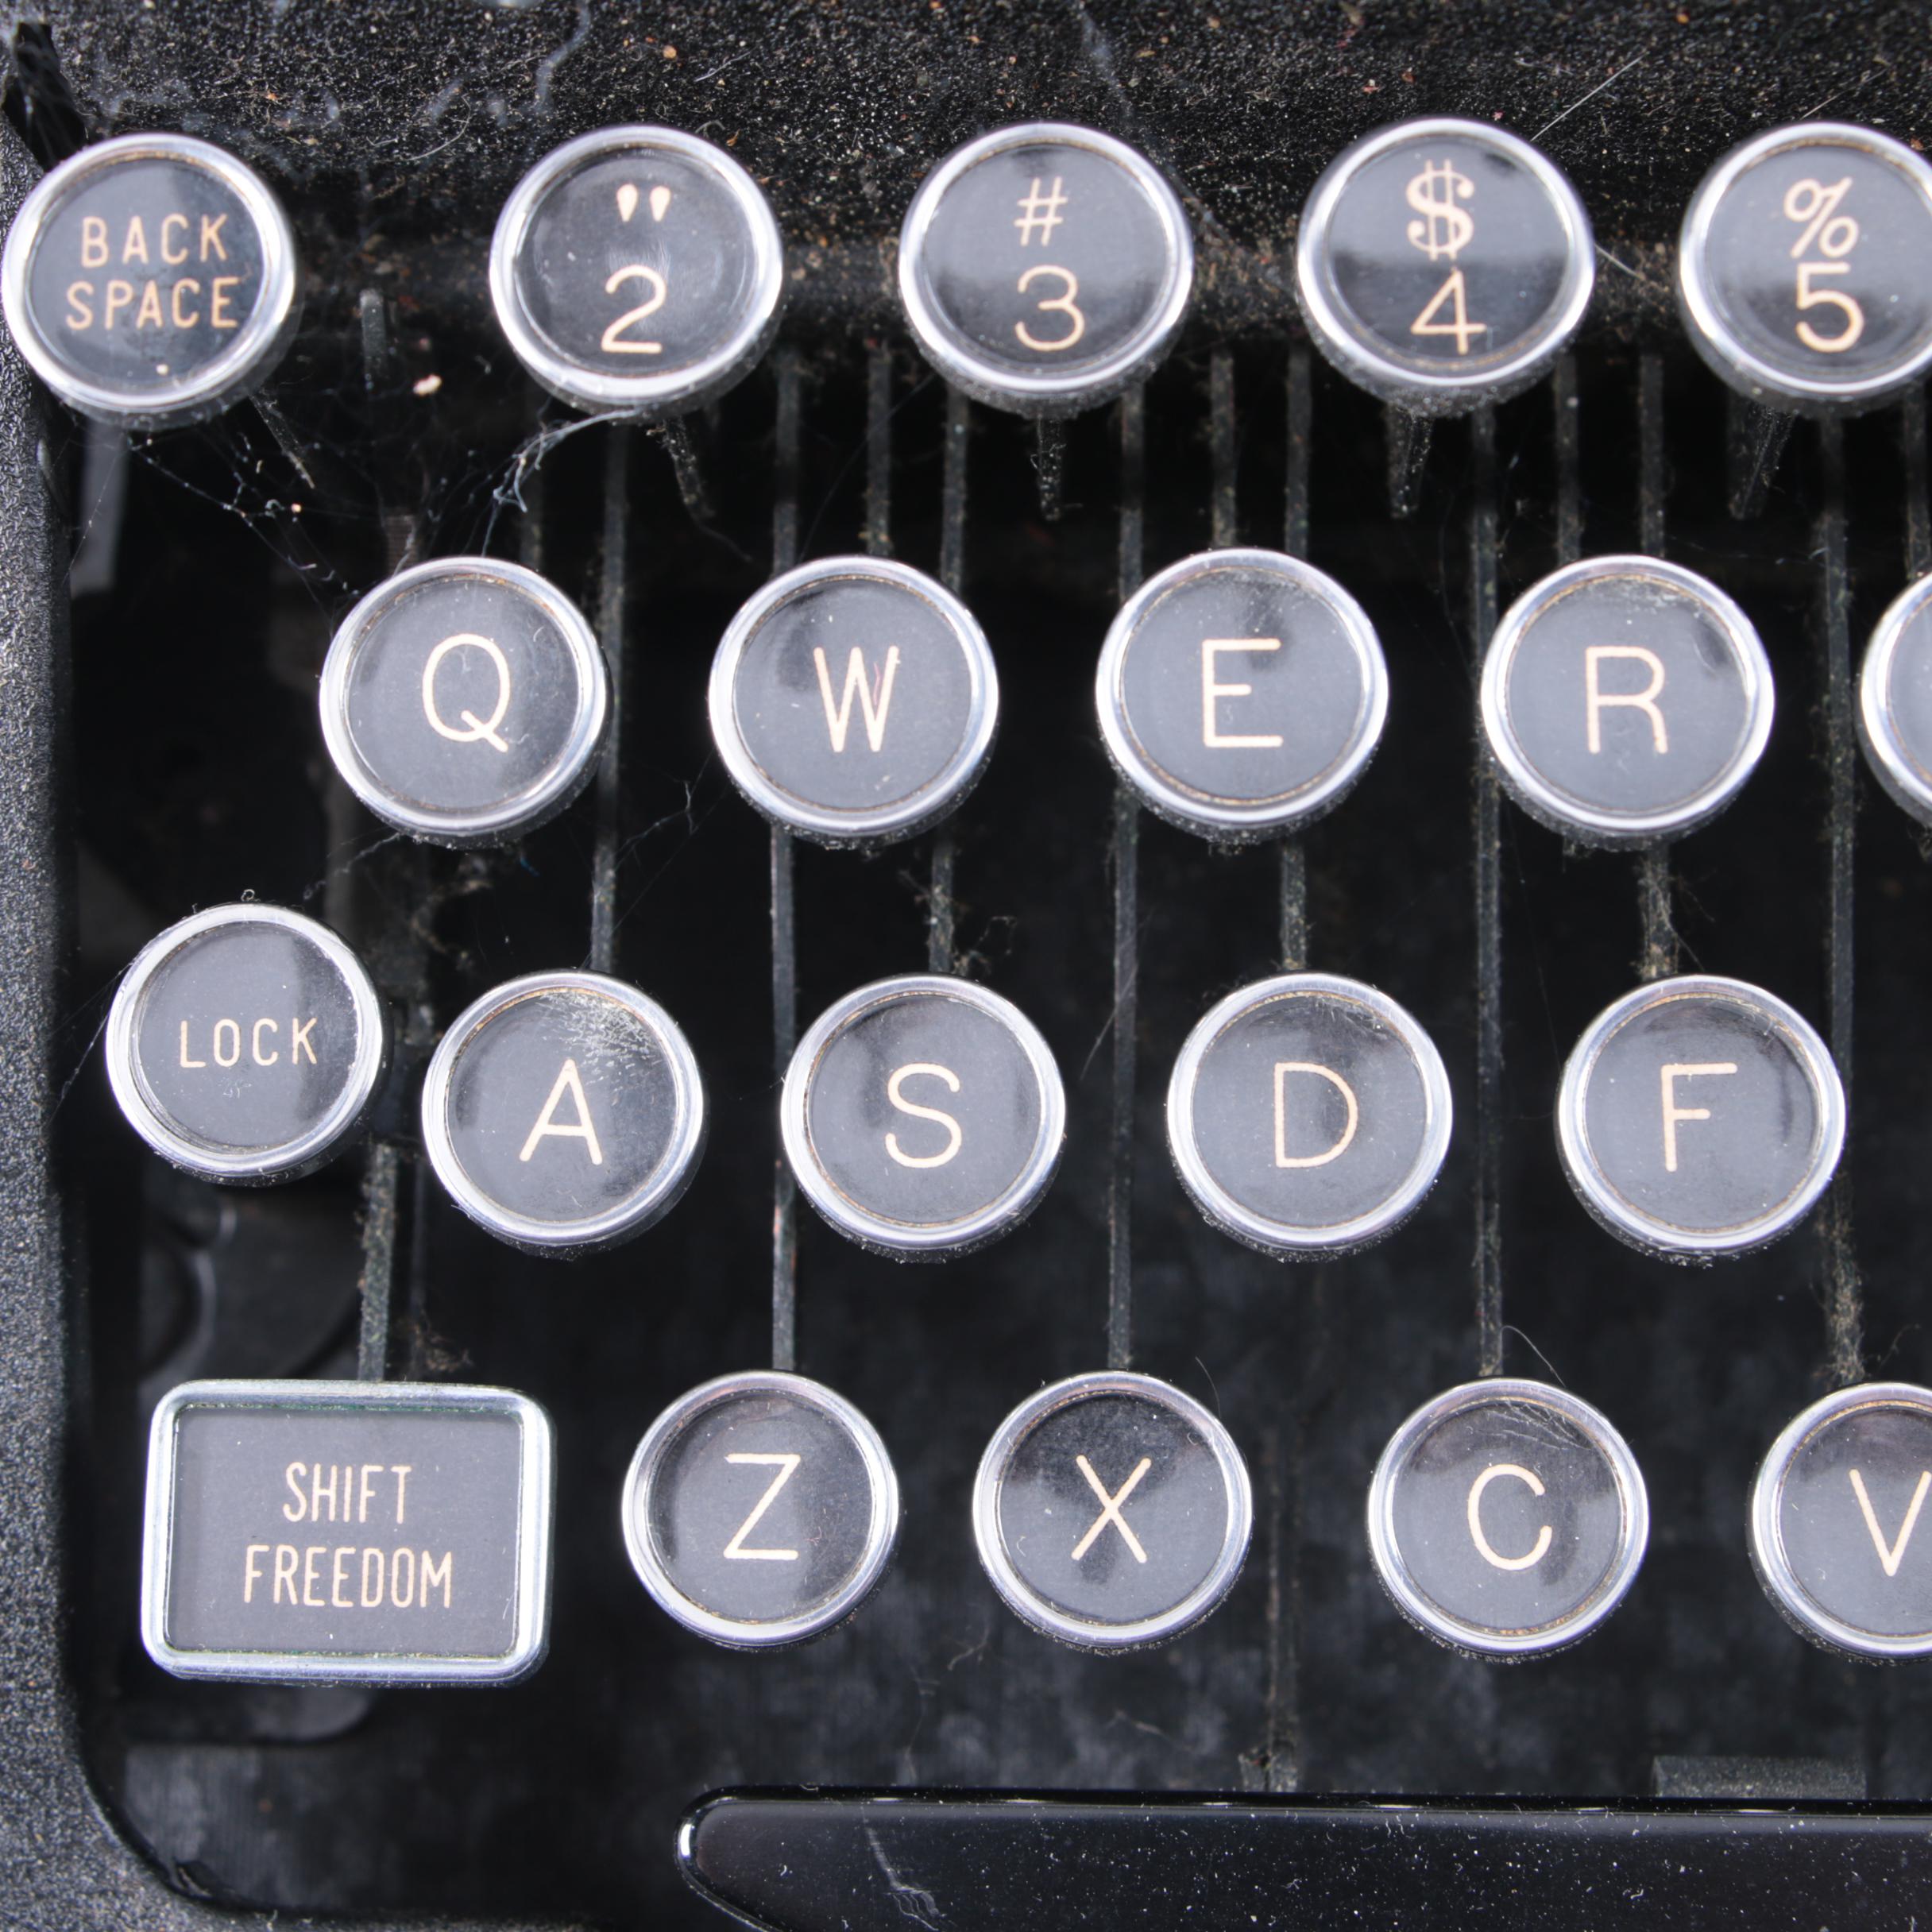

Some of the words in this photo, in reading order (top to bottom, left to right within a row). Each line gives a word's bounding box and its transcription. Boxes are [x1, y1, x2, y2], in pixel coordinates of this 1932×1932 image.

[82, 214, 227, 267] BACK
[1014, 178, 1066, 245] #
[1406, 161, 1474, 260] $
[1783, 178, 1856, 258] %
[68, 276, 240, 330] SPACE
[601, 265, 667, 355] 2
[1014, 265, 1085, 351] 3
[1411, 267, 1486, 354] 4
[1795, 261, 1864, 352] 5
[422, 633, 512, 752] Q
[813, 646, 898, 751] W
[1202, 637, 1283, 748] E
[1586, 646, 1666, 752] R
[181, 1017, 318, 1068] LOCK
[521, 1059, 602, 1165] A
[885, 1062, 963, 1167] S
[1274, 1061, 1359, 1166] D
[1661, 1062, 1736, 1169] F
[283, 1462, 412, 1521] SHIFT
[724, 1452, 801, 1561] Z
[1072, 1455, 1151, 1563] X
[1467, 1463, 1551, 1567] C
[1848, 1468, 1932, 1575] V
[245, 1544, 453, 1606] FREEDOM
